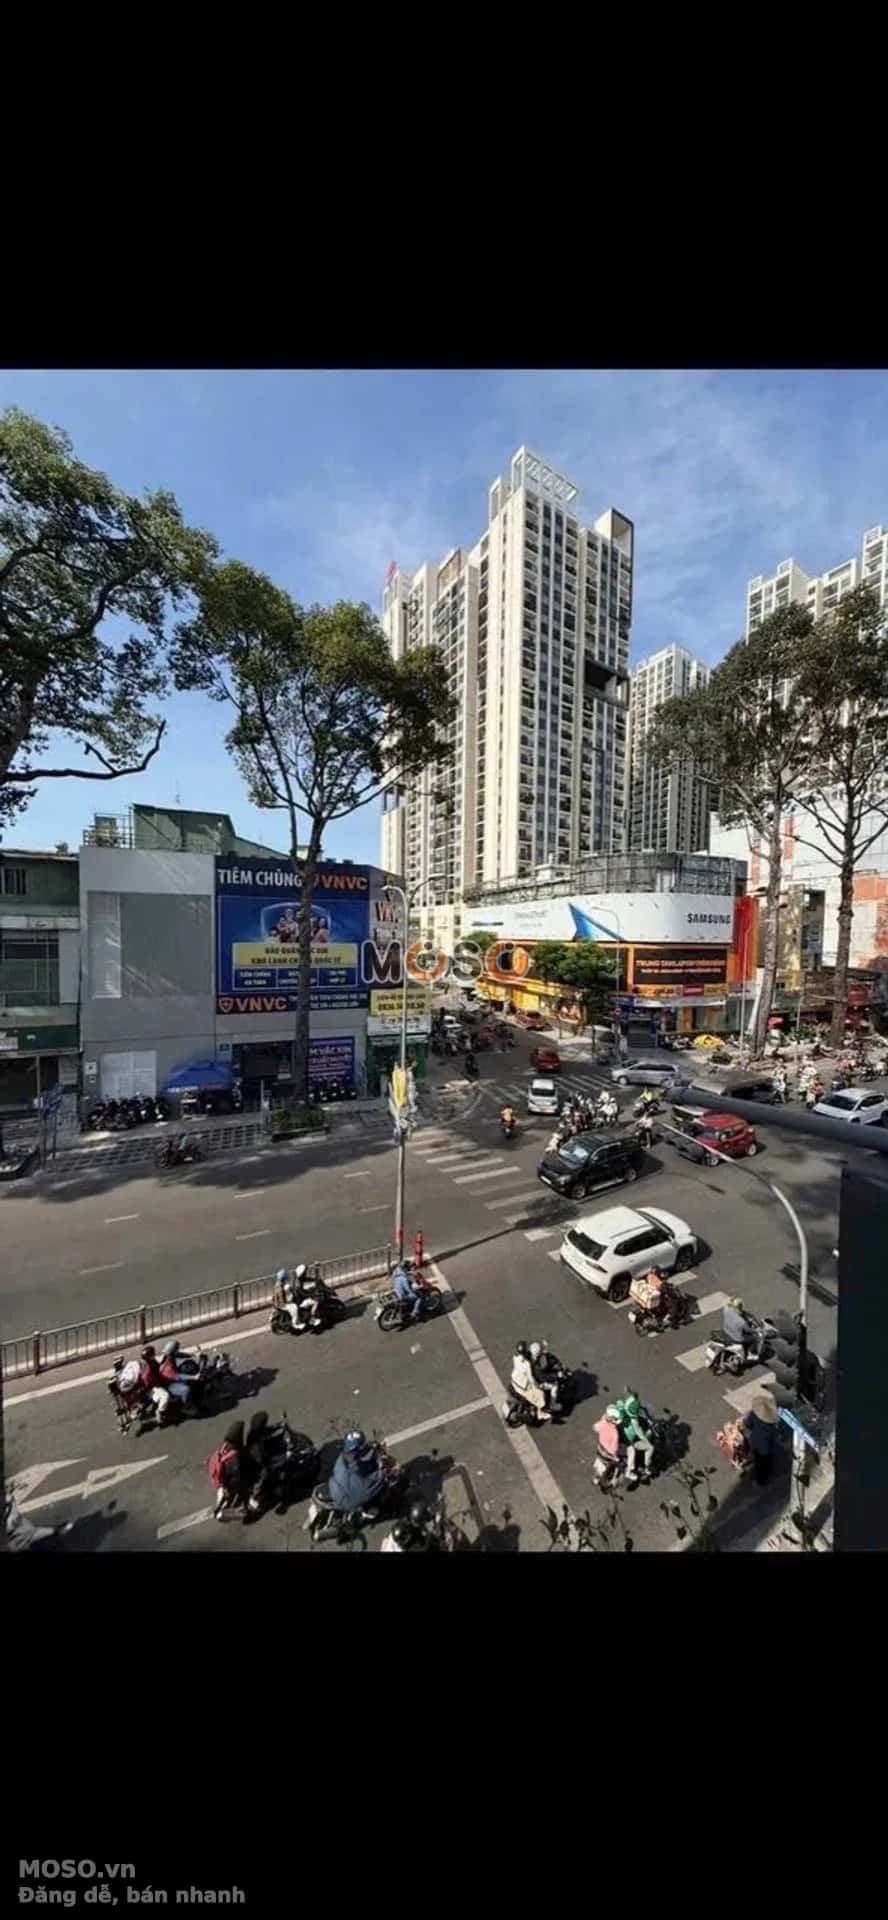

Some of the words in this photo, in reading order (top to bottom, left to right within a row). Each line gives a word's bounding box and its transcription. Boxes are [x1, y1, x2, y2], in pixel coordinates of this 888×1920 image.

[217, 866, 253, 885] TIÊM
[321, 874, 369, 890] VNVC
[687, 913, 731, 924] SAMSUNG
[236, 996, 287, 1012] VNVC
